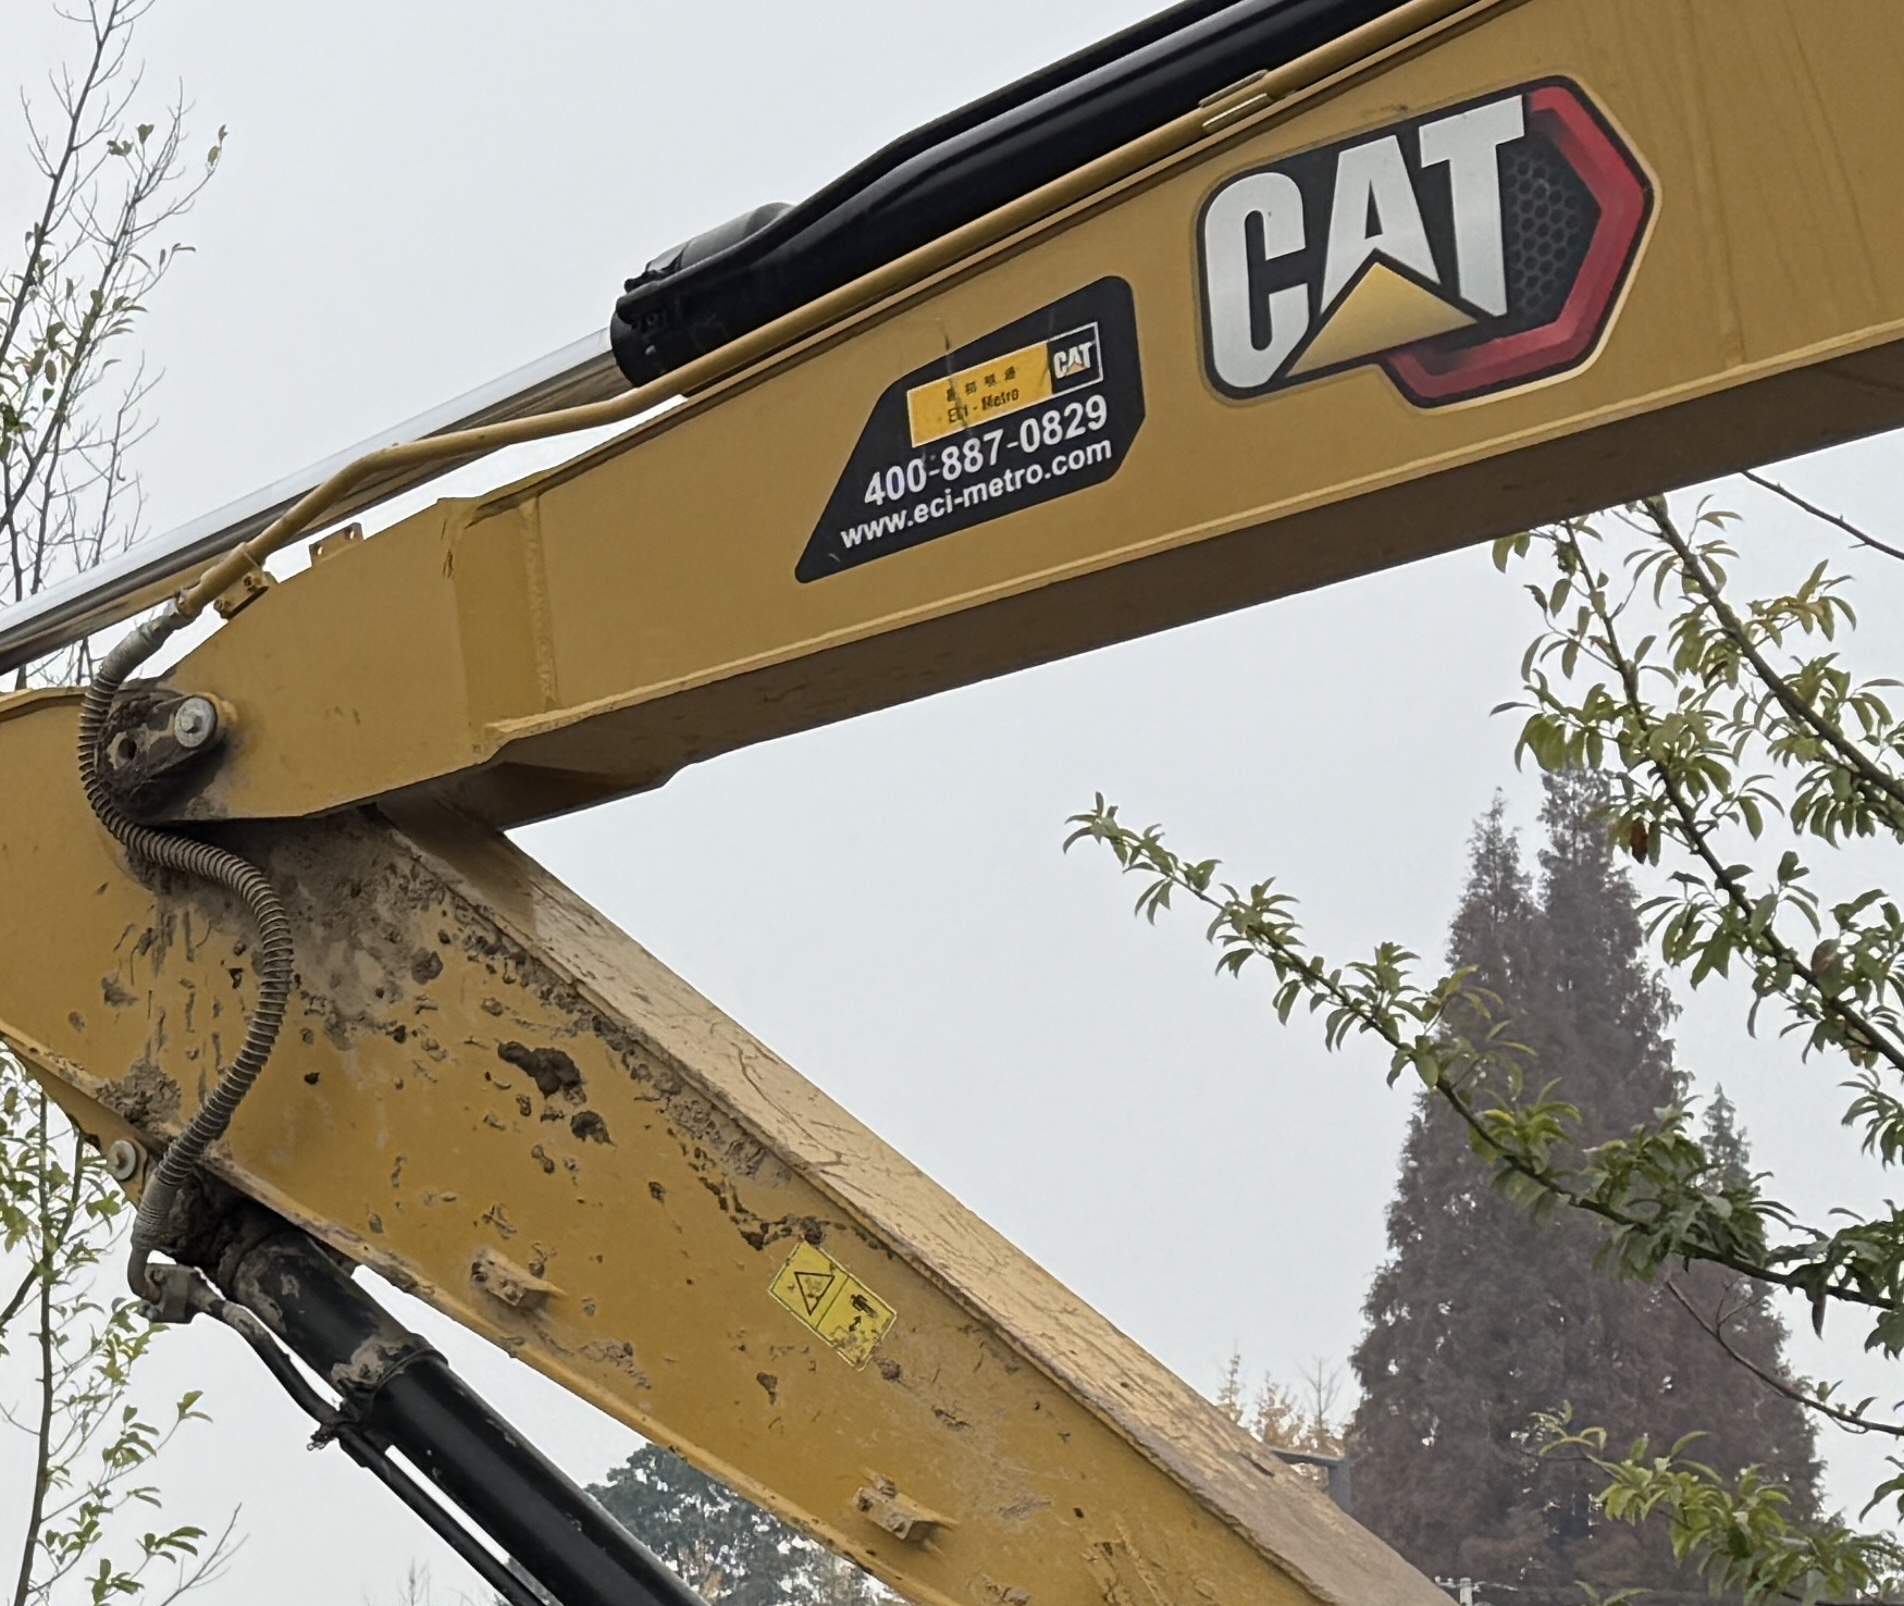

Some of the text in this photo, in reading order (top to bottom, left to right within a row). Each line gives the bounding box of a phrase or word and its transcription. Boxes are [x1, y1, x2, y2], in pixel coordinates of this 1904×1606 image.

[1205, 94, 1524, 388] CAT
[1053, 341, 1094, 379] CAT
[840, 438, 1112, 549] www.eci-metro.com
[864, 394, 1108, 507] 400-887-0829
